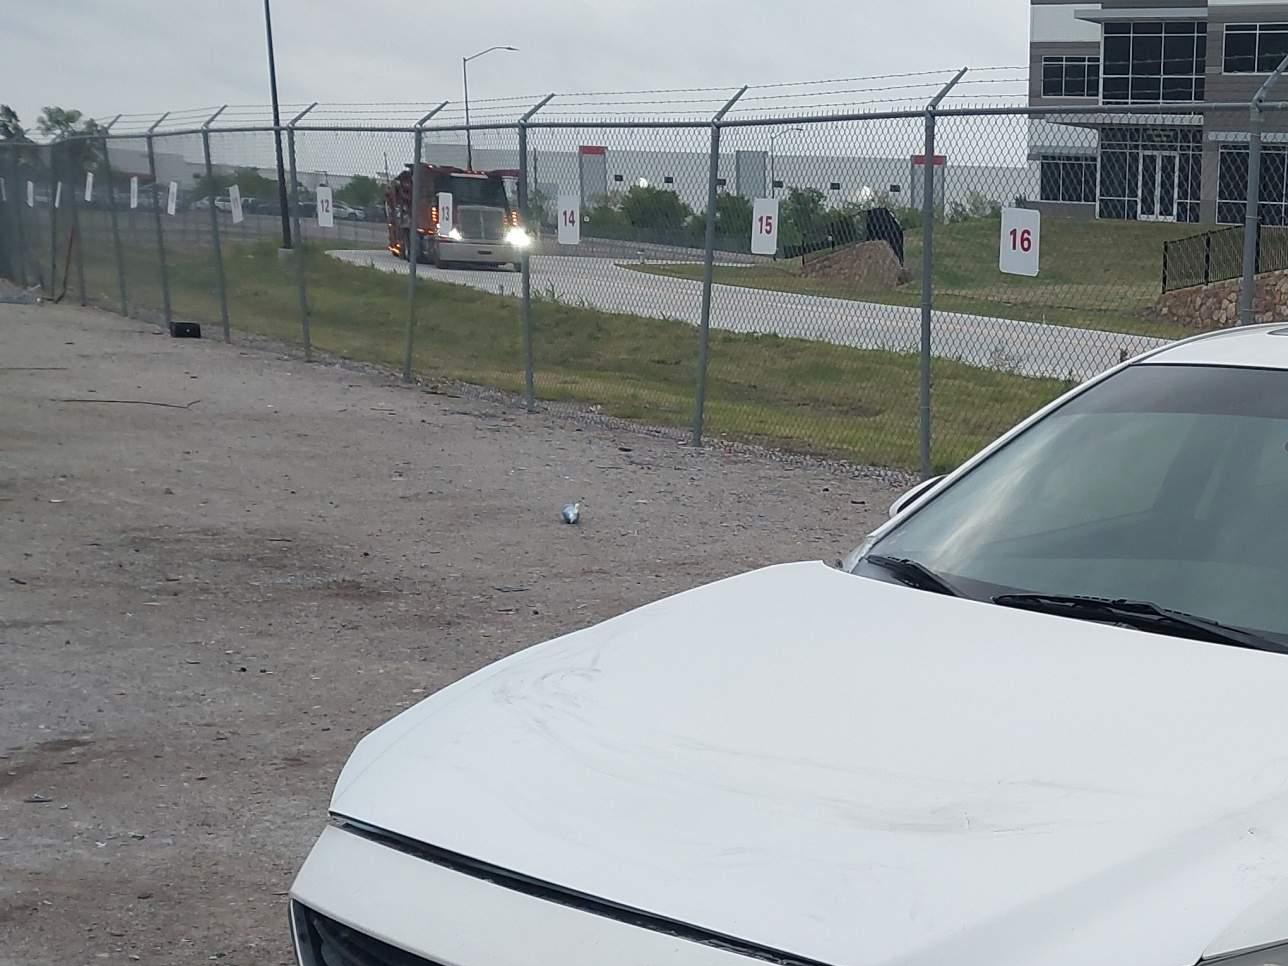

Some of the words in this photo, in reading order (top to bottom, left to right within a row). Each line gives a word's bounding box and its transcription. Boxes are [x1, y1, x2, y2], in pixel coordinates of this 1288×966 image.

[320, 199, 330, 213] 12
[441, 206, 450, 221] 13
[562, 210, 576, 227] 14
[758, 215, 773, 235] 15
[1009, 228, 1032, 252] 16
